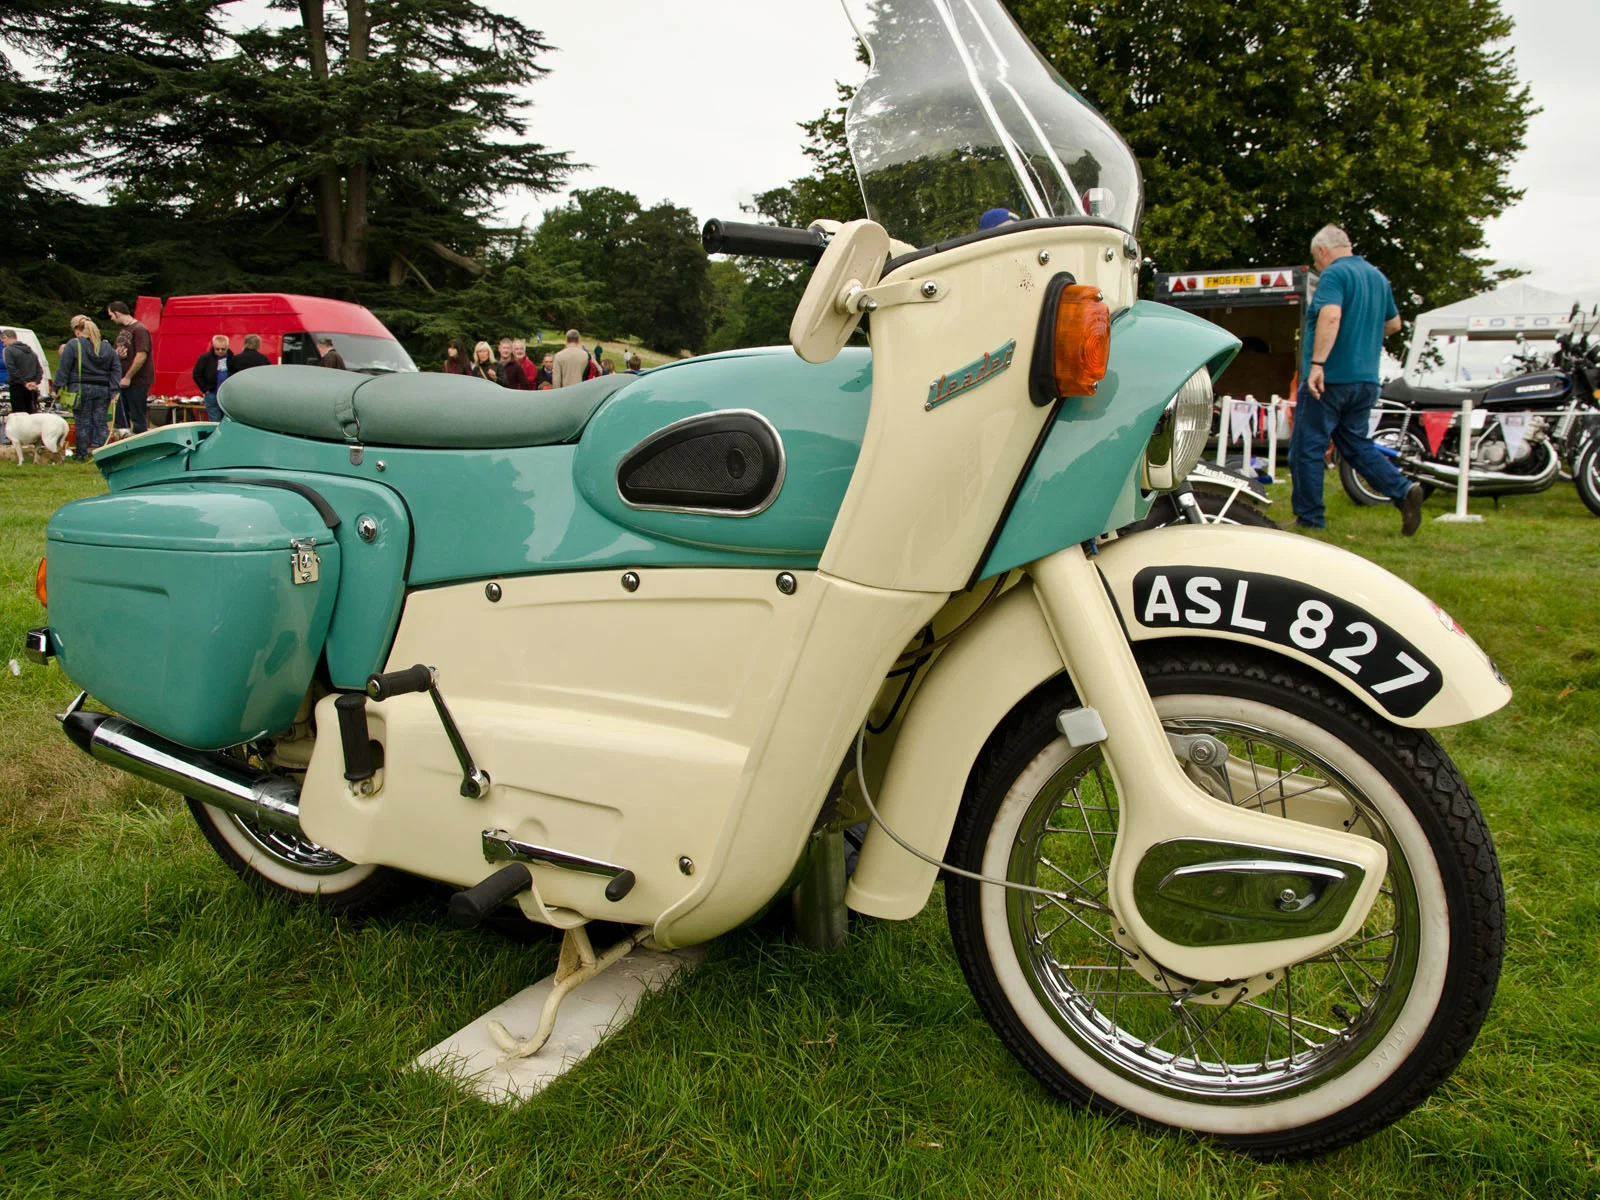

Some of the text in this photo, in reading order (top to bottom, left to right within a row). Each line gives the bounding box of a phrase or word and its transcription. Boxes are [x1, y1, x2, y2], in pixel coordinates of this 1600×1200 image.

[1144, 575, 1430, 694] ASL 827
[1371, 1025, 1409, 1069] ATLAS
